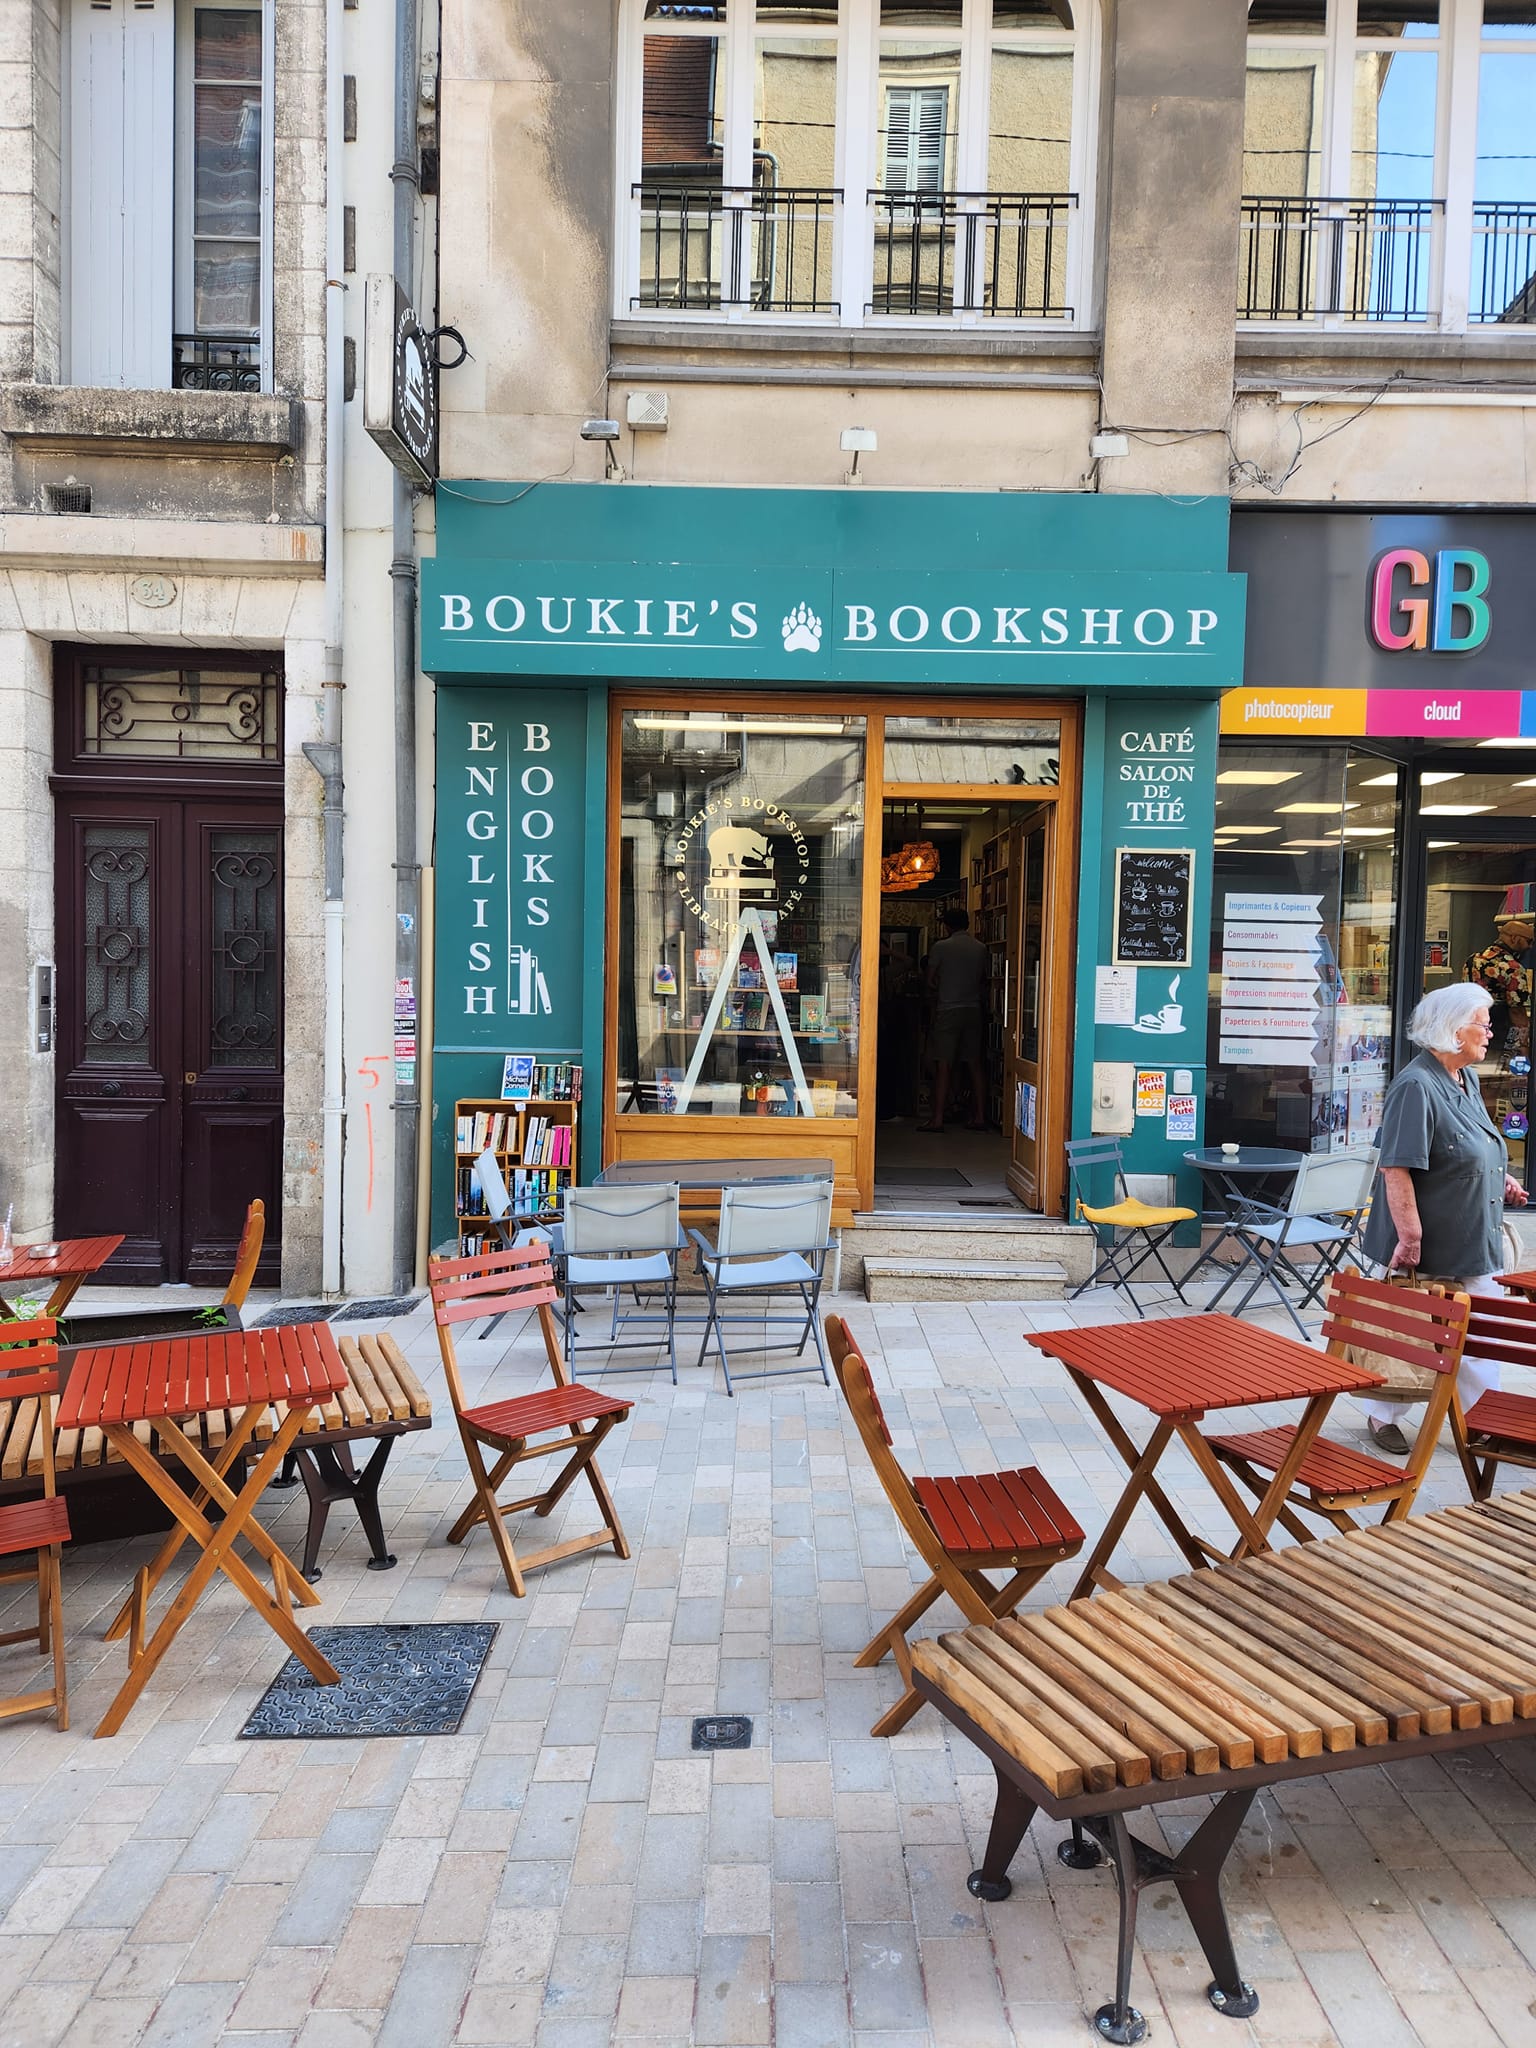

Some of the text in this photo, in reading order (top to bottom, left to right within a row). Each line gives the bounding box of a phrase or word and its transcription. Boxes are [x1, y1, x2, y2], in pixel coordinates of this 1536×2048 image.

[141, 581, 165, 601] 34
[1371, 548, 1491, 652] GB
[439, 594, 1219, 646] BOUKIE'S BOOKSHOP
[1244, 699, 1335, 723] photocopieur
[1424, 700, 1462, 721] cloud
[1119, 727, 1196, 753] CAFÉ
[1119, 764, 1196, 782] SALON
[1143, 785, 1171, 799] DE
[1126, 797, 1186, 822] THÉ
[521, 723, 555, 926] BOOKS
[675, 796, 810, 868] BOUKIE'S BOOKSHOP
[463, 721, 499, 1014] ENGLISH
[1136, 856, 1177, 870] welcome
[1228, 901, 1312, 912] Imprimantes & Copieurs
[1227, 930, 1279, 940] Consommables
[1226, 959, 1250, 969] Copies
[1251, 960, 1256, 968] &
[1225, 988, 1308, 999] Impressions numériques
[1224, 1017, 1309, 1027] Papeteries & Fournitures
[1224, 1045, 1254, 1056] Tampons
[1138, 1074, 1163, 1087] petit
[1169, 1098, 1193, 1110] petit
